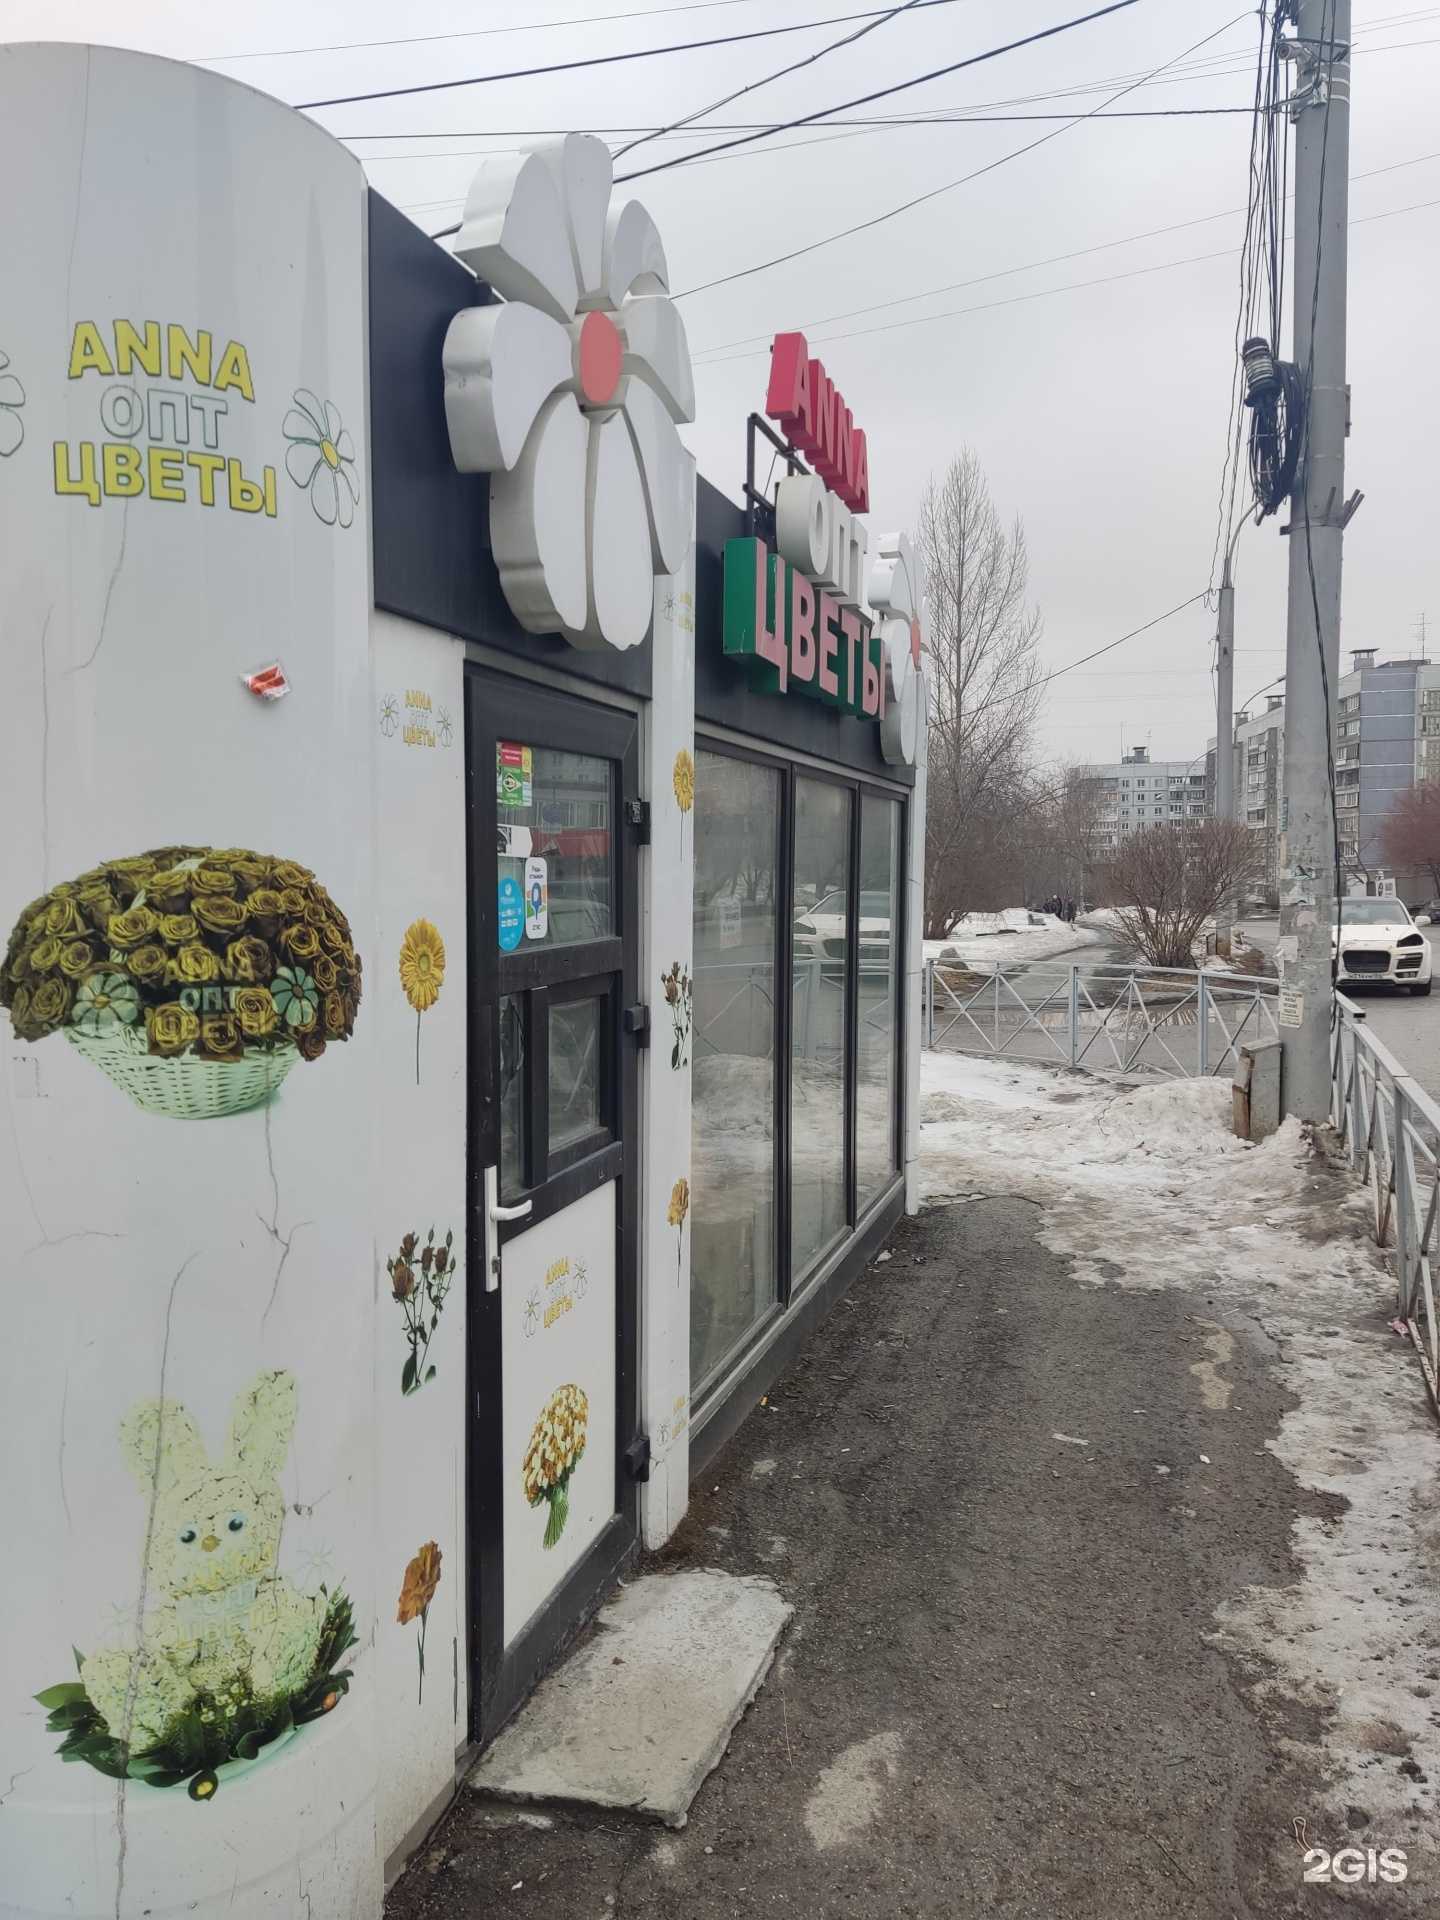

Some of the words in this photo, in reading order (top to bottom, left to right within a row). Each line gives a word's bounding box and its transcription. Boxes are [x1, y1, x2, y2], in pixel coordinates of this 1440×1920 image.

[68, 319, 255, 403] ANNA
[100, 384, 228, 449] ОПТ
[53, 441, 277, 517] ЦВЕТЫ
[774, 332, 869, 513] ANNA
[785, 474, 868, 625] ОПТ
[734, 537, 885, 720] ЦВЕТЫ
